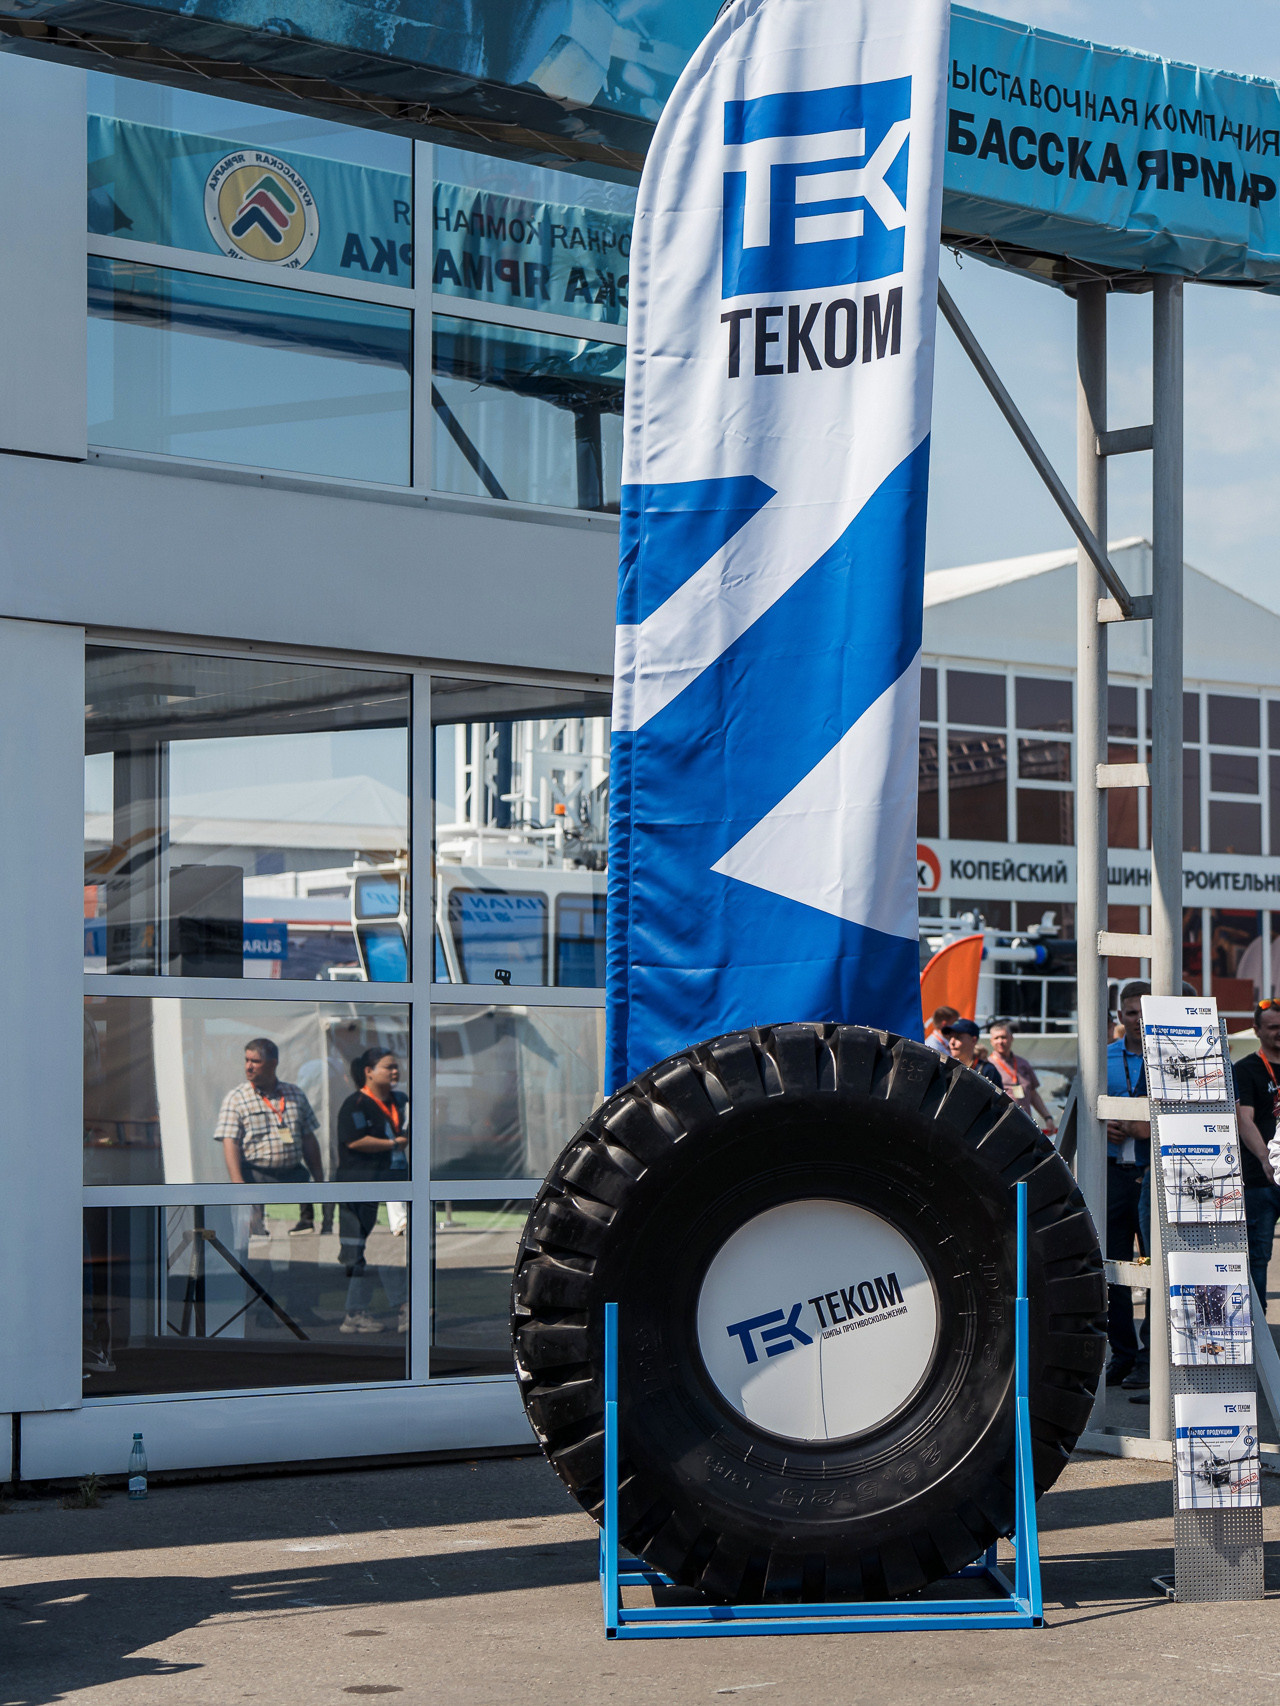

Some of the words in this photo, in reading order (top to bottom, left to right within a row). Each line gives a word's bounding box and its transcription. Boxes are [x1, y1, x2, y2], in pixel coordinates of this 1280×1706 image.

[947, 59, 1139, 126] ЫСТАВОЧНАЯ
[1144, 102, 1280, 157] КОМПАНИЯ
[720, 286, 903, 379] ТЕКОМ
[950, 858, 1068, 884] КОПЕЙСКИЙ
[1169, 1028, 1196, 1036] ПРОДУКЦИИ
[807, 1272, 905, 1329] ТЕКОМ
[822, 1326, 842, 1340] ШИПЫ
[842, 1305, 908, 1334] ПРОТИВОСКОЛЬЖЕНИЯ
[1206, 1428, 1233, 1436] ПРОДУКЦИИ
